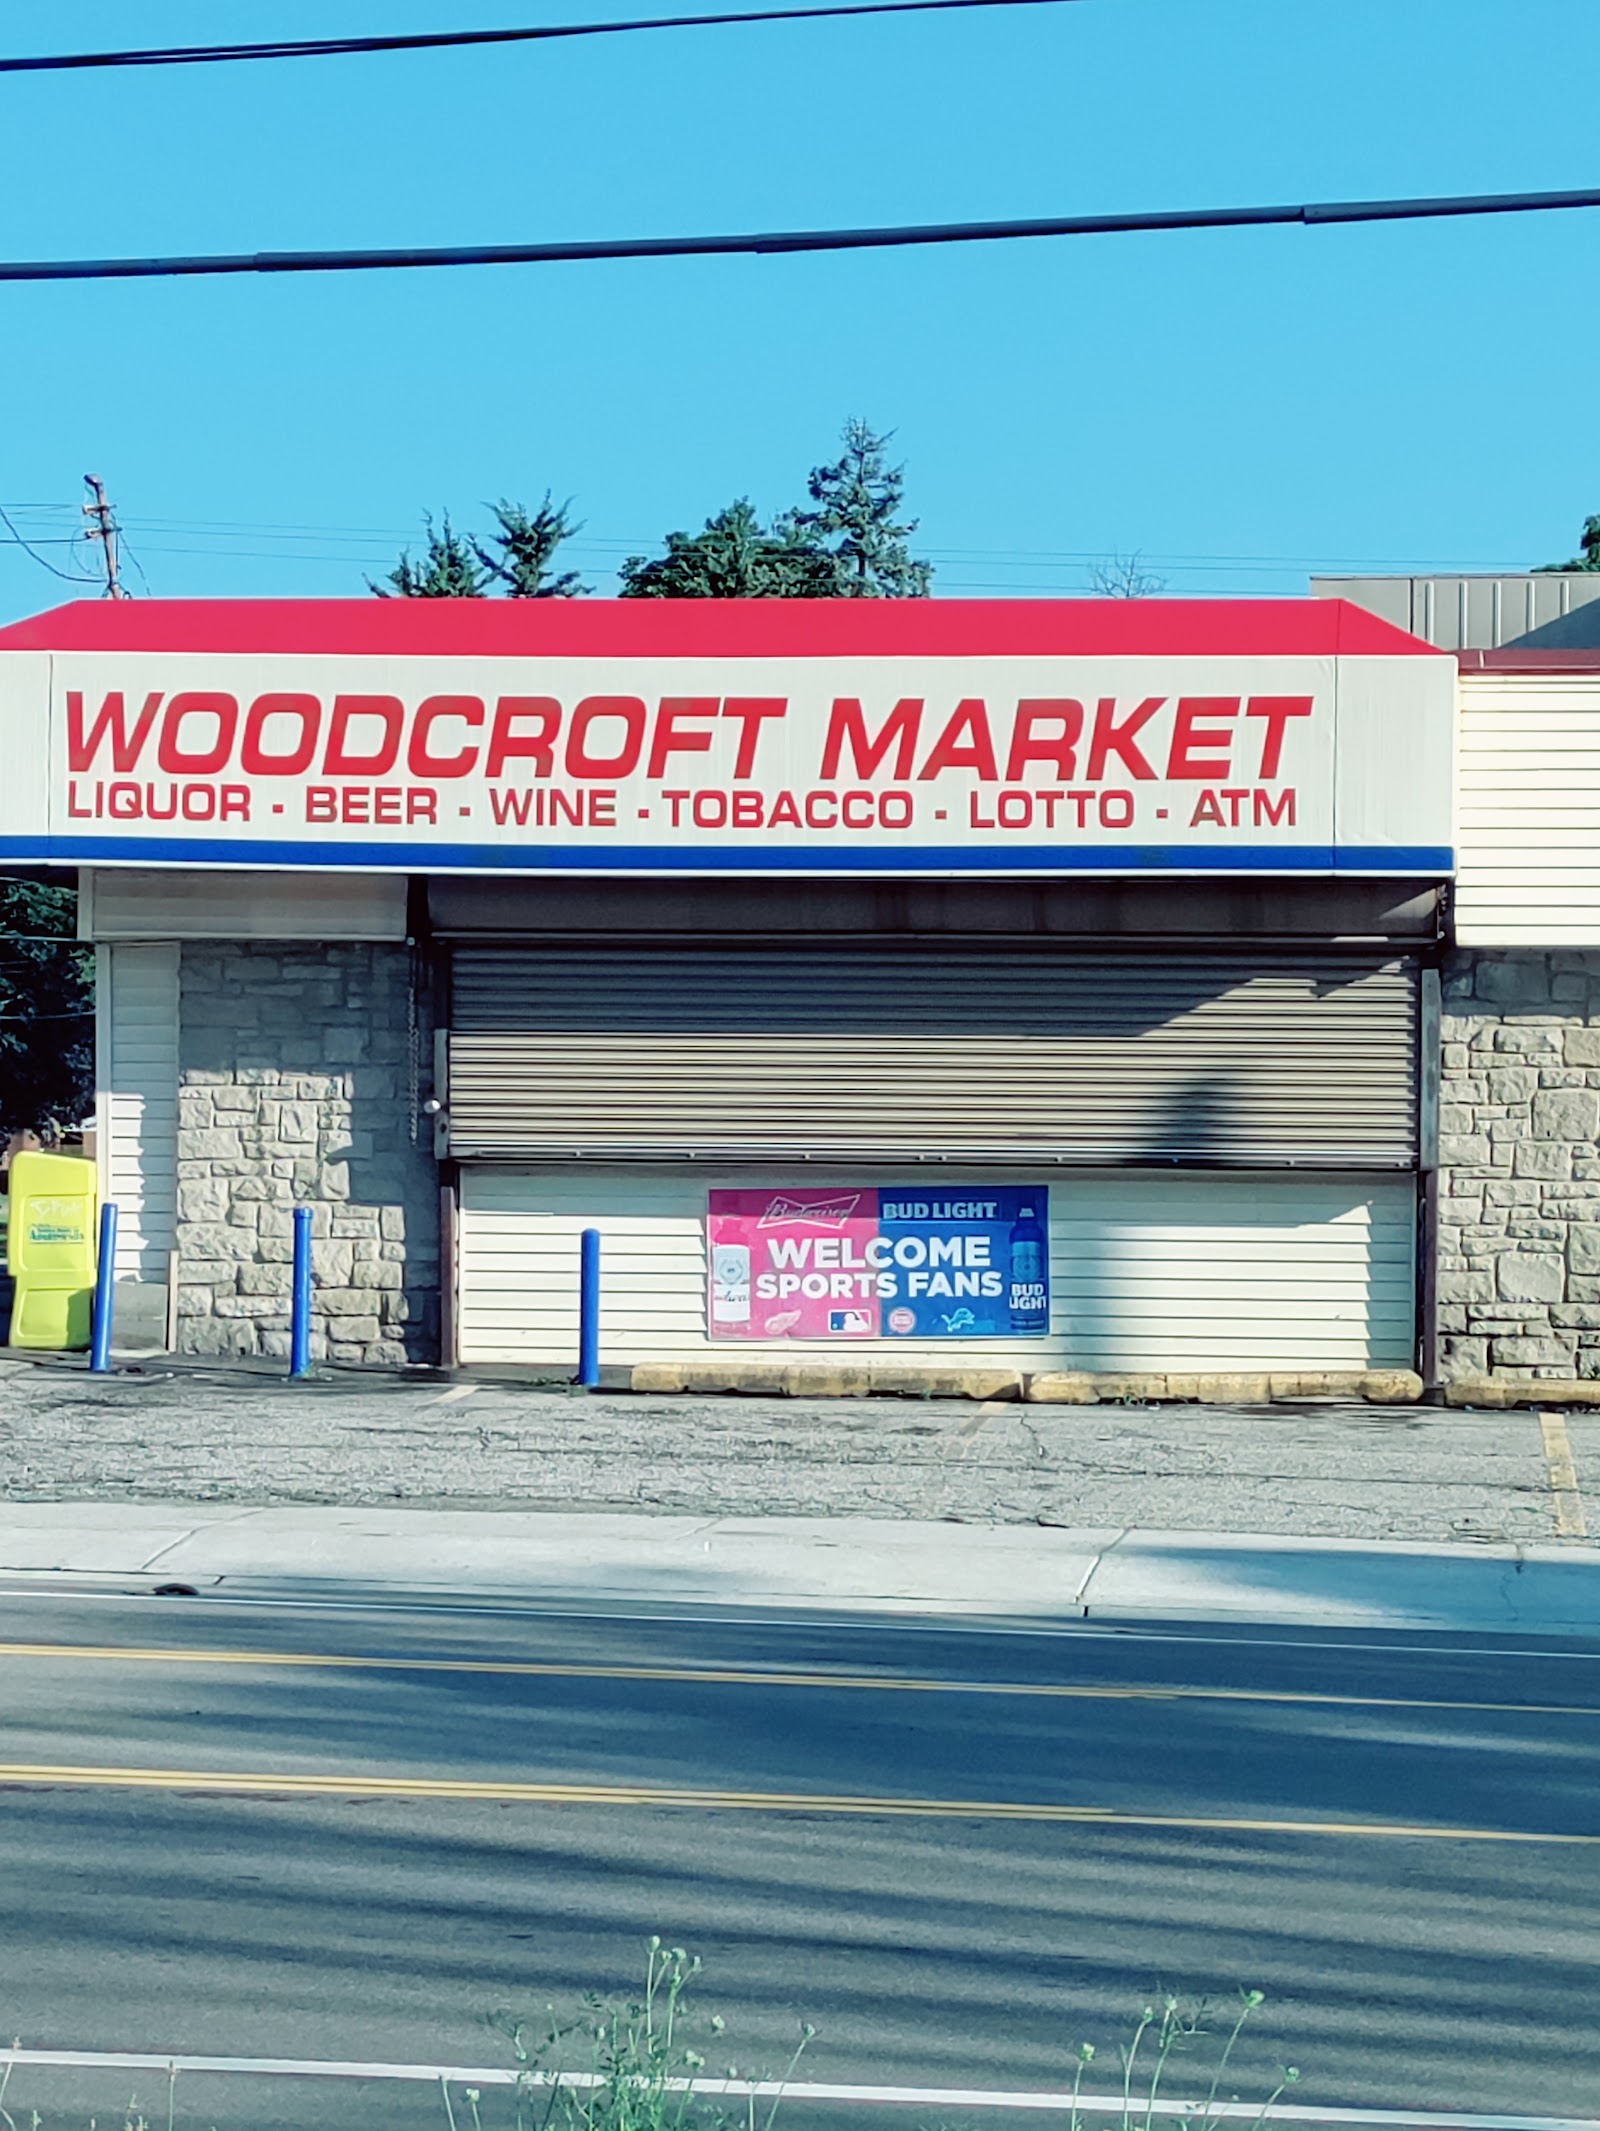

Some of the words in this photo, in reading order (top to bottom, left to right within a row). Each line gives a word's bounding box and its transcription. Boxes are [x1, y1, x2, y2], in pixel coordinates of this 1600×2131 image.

[67, 691, 788, 780] WOODCROFT
[821, 696, 1313, 781] MARKET
[68, 781, 251, 821] LIQUOR
[305, 786, 437, 826] BEER
[490, 788, 617, 827] WINE
[662, 790, 914, 829] TOBACCO
[970, 790, 1135, 829] LOTTO
[1190, 788, 1296, 827] ATM
[883, 1203, 929, 1219] BUD
[933, 1202, 997, 1218] LIGHT
[767, 1236, 991, 1269] WELCOME
[756, 1273, 898, 1299] SPORTS
[908, 1272, 1003, 1298] FANS
[1011, 1283, 1044, 1296] BUD
